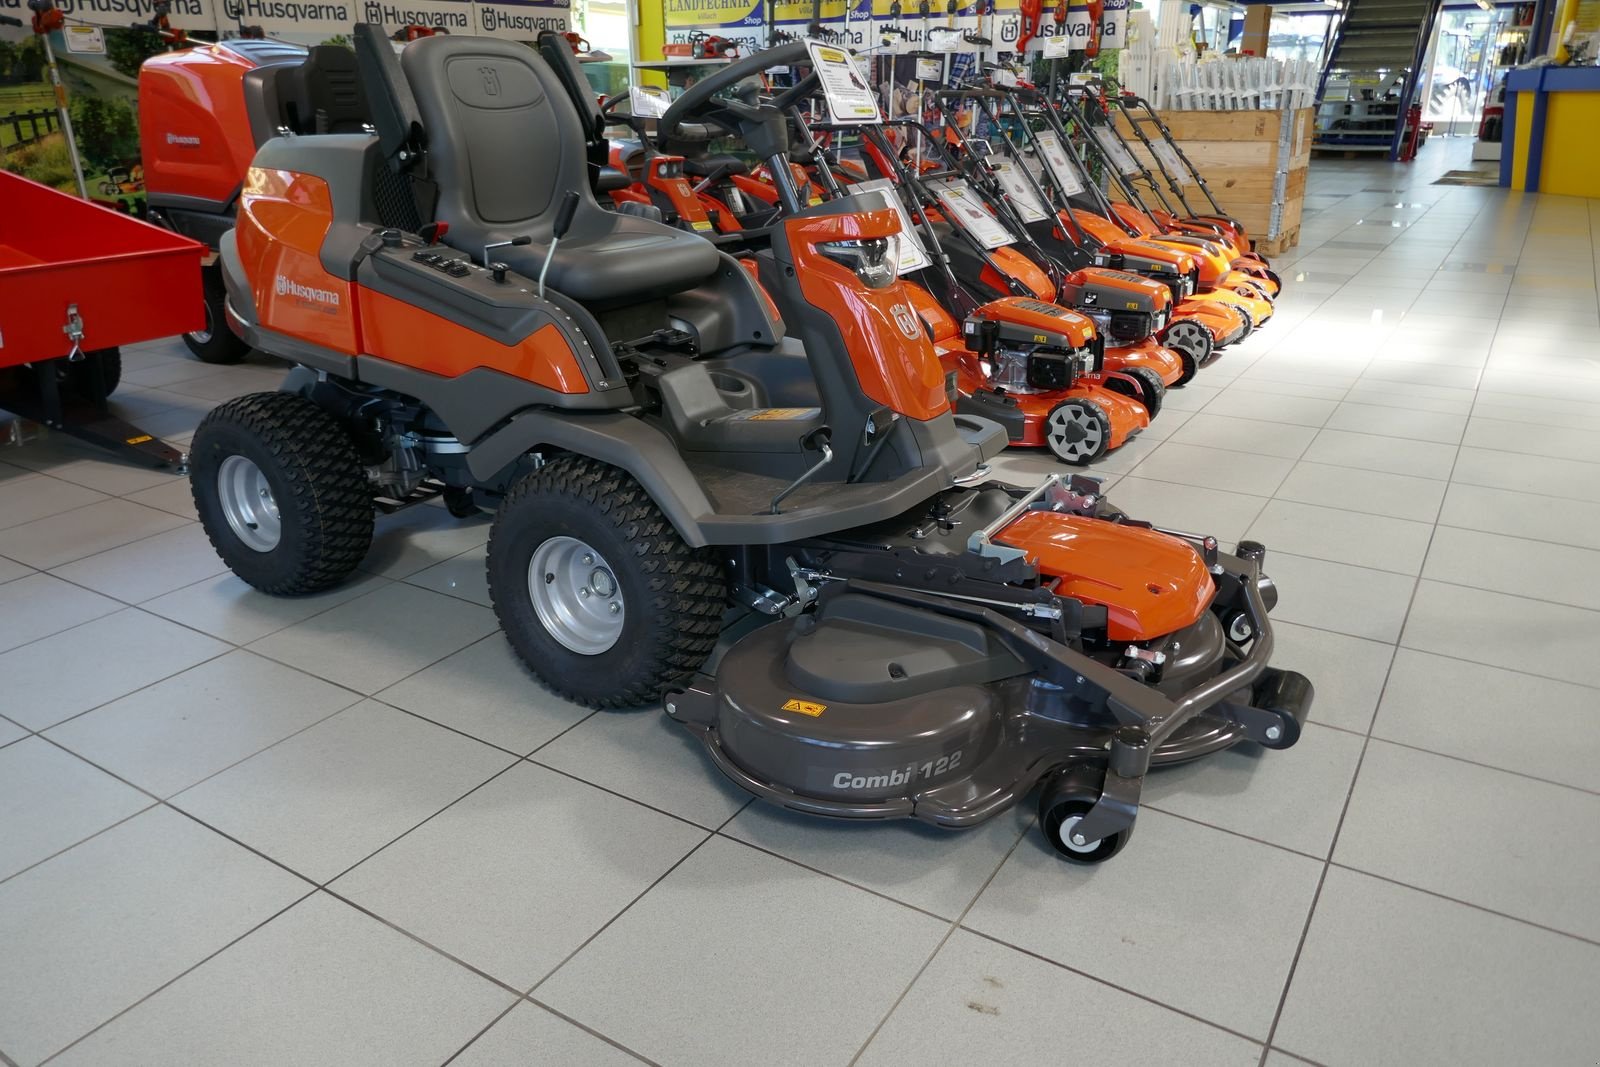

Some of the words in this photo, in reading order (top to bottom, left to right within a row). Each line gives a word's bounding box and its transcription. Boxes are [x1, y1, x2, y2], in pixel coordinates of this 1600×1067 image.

[246, 0, 348, 22] Husqvarna
[383, 6, 467, 27] Husqvarna
[744, 16, 762, 25] Shop
[850, 10, 869, 20] Shop
[497, 12, 566, 32] Husqvarna
[286, 279, 339, 305] Husqvarna
[833, 768, 911, 790] Combi
[919, 750, 963, 779] 122
